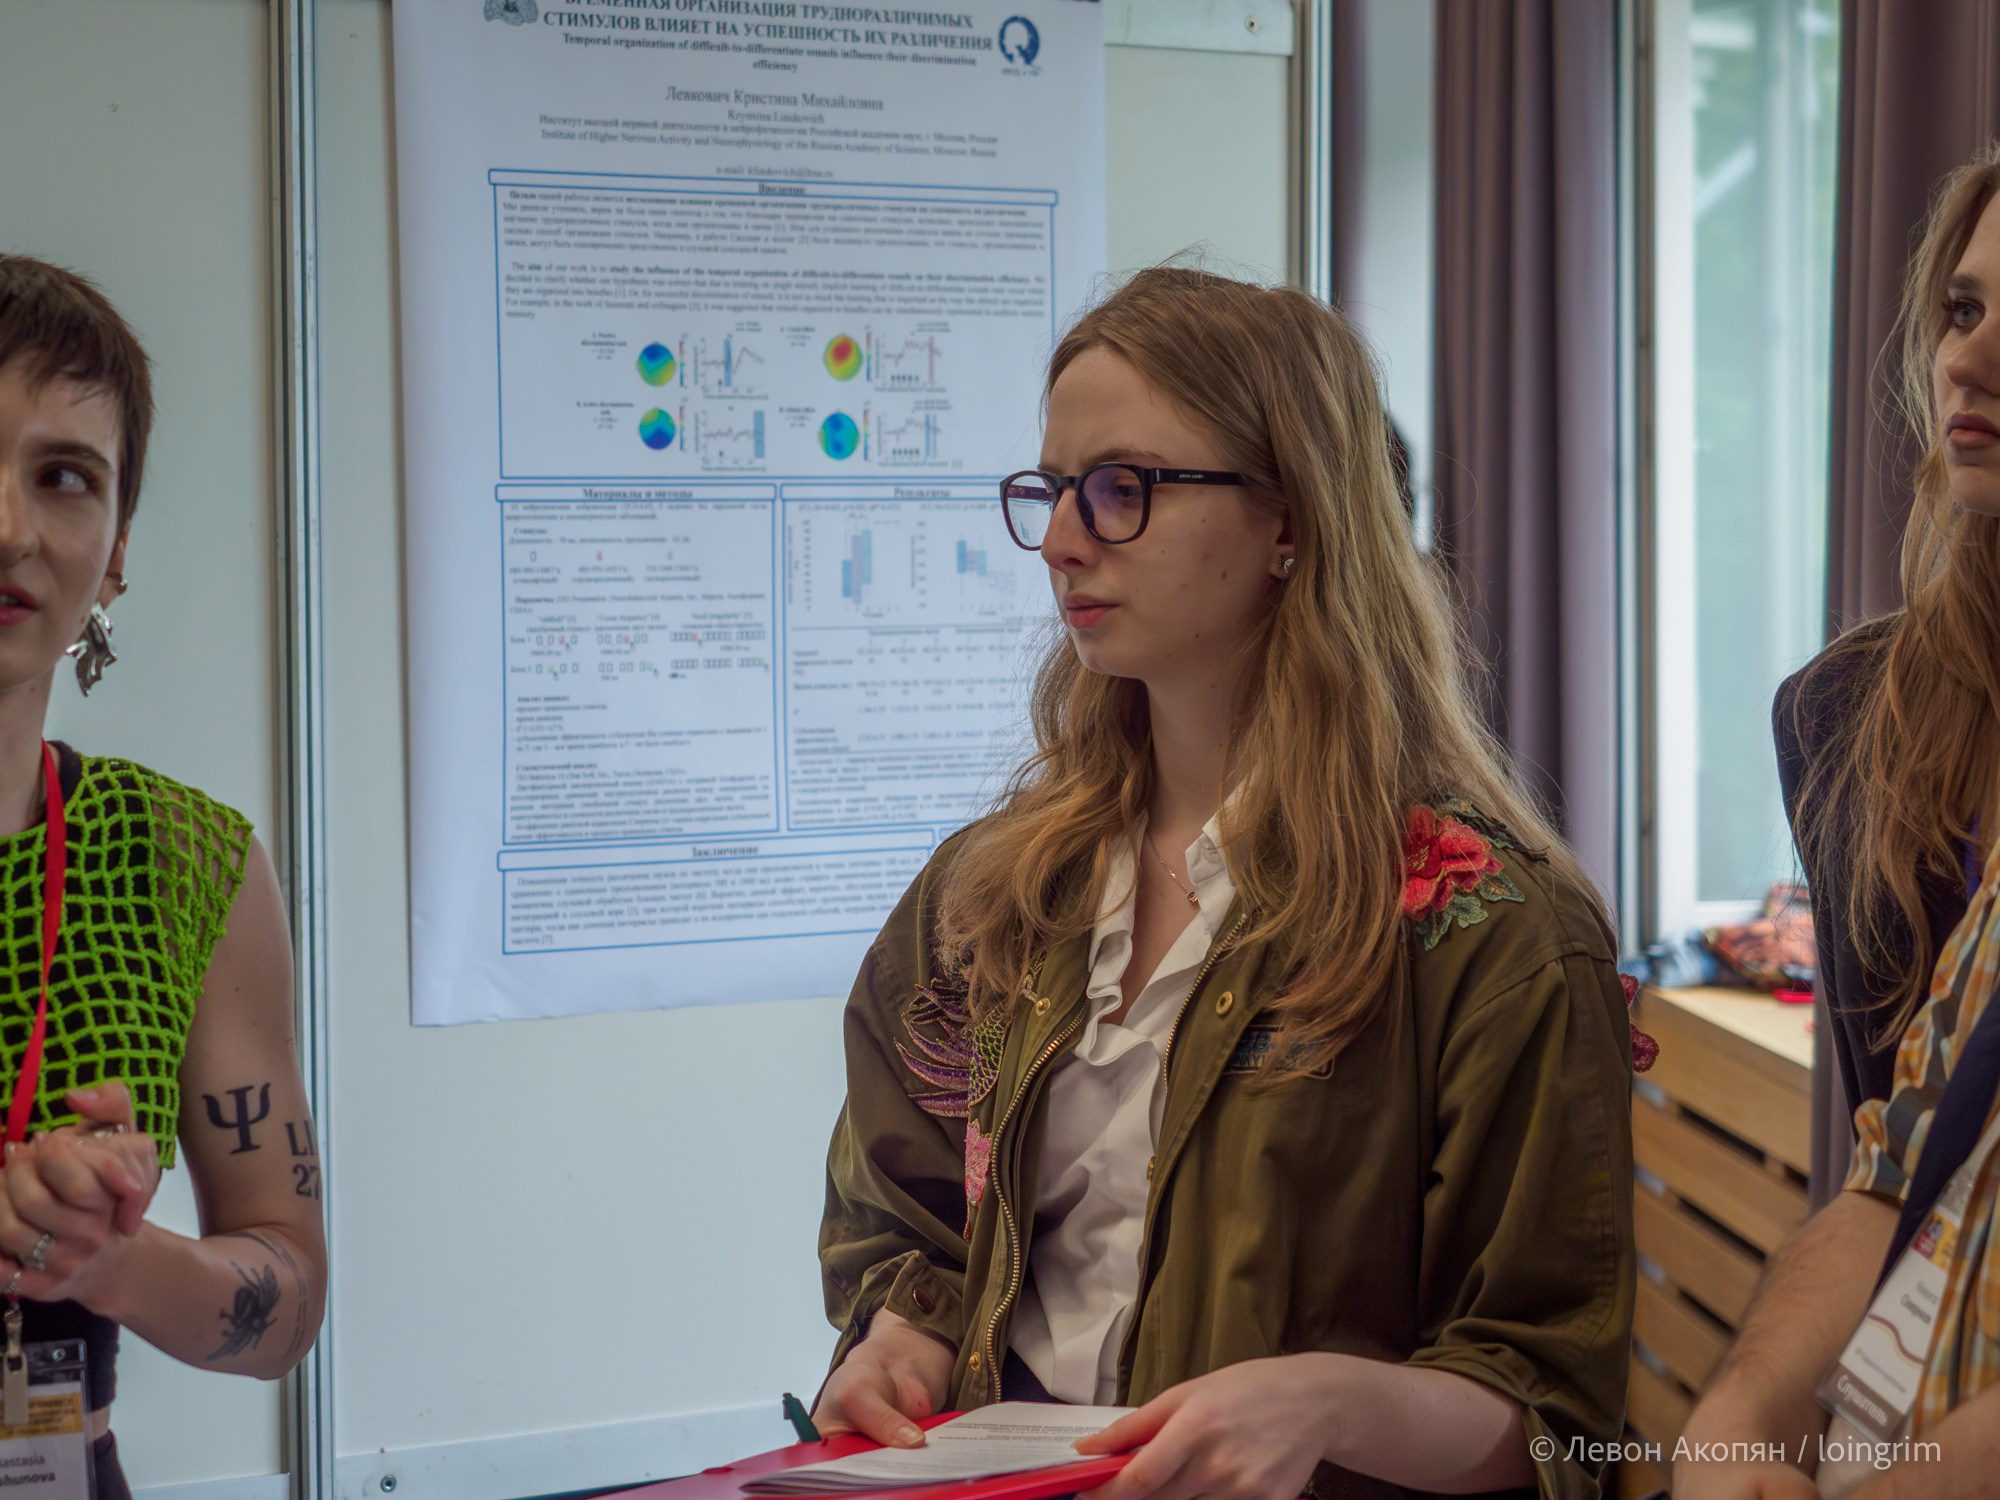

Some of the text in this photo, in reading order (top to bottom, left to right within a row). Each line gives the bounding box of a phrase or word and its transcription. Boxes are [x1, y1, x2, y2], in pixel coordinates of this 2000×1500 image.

[675, 0, 797, 17] ОРГАНИЗАЦИЯ
[801, 5, 973, 29] ТРУДНОРАЗЛИЧИМЫХ
[543, 12, 993, 51] СТИМУЛОВ ВЛИЯЕТ НА УСПЕШНОСТЬ ИХ РАЗЛИЧЕНИЯ
[562, 33, 611, 48] Temporal
[613, 38, 675, 50] organization
[678, 39, 689, 50] of
[840, 48, 883, 62] influence
[910, 52, 976, 66] discrimination
[664, 86, 884, 111] Левкович Кристина Михайловна
[582, 487, 643, 500] Материалы
